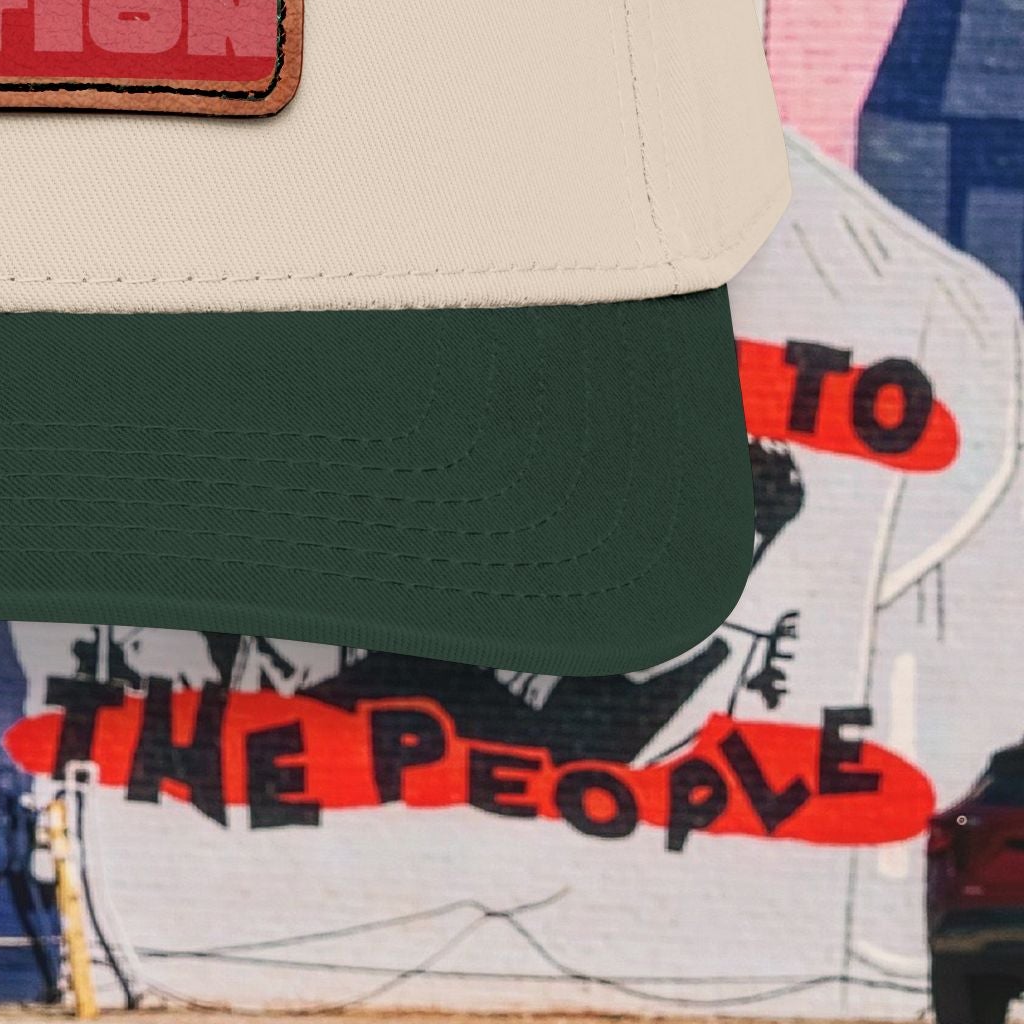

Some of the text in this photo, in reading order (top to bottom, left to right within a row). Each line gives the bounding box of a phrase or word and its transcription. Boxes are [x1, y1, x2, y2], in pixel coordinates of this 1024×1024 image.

[784, 339, 933, 455] TO
[46, 675, 882, 853] THE PEOPLE
